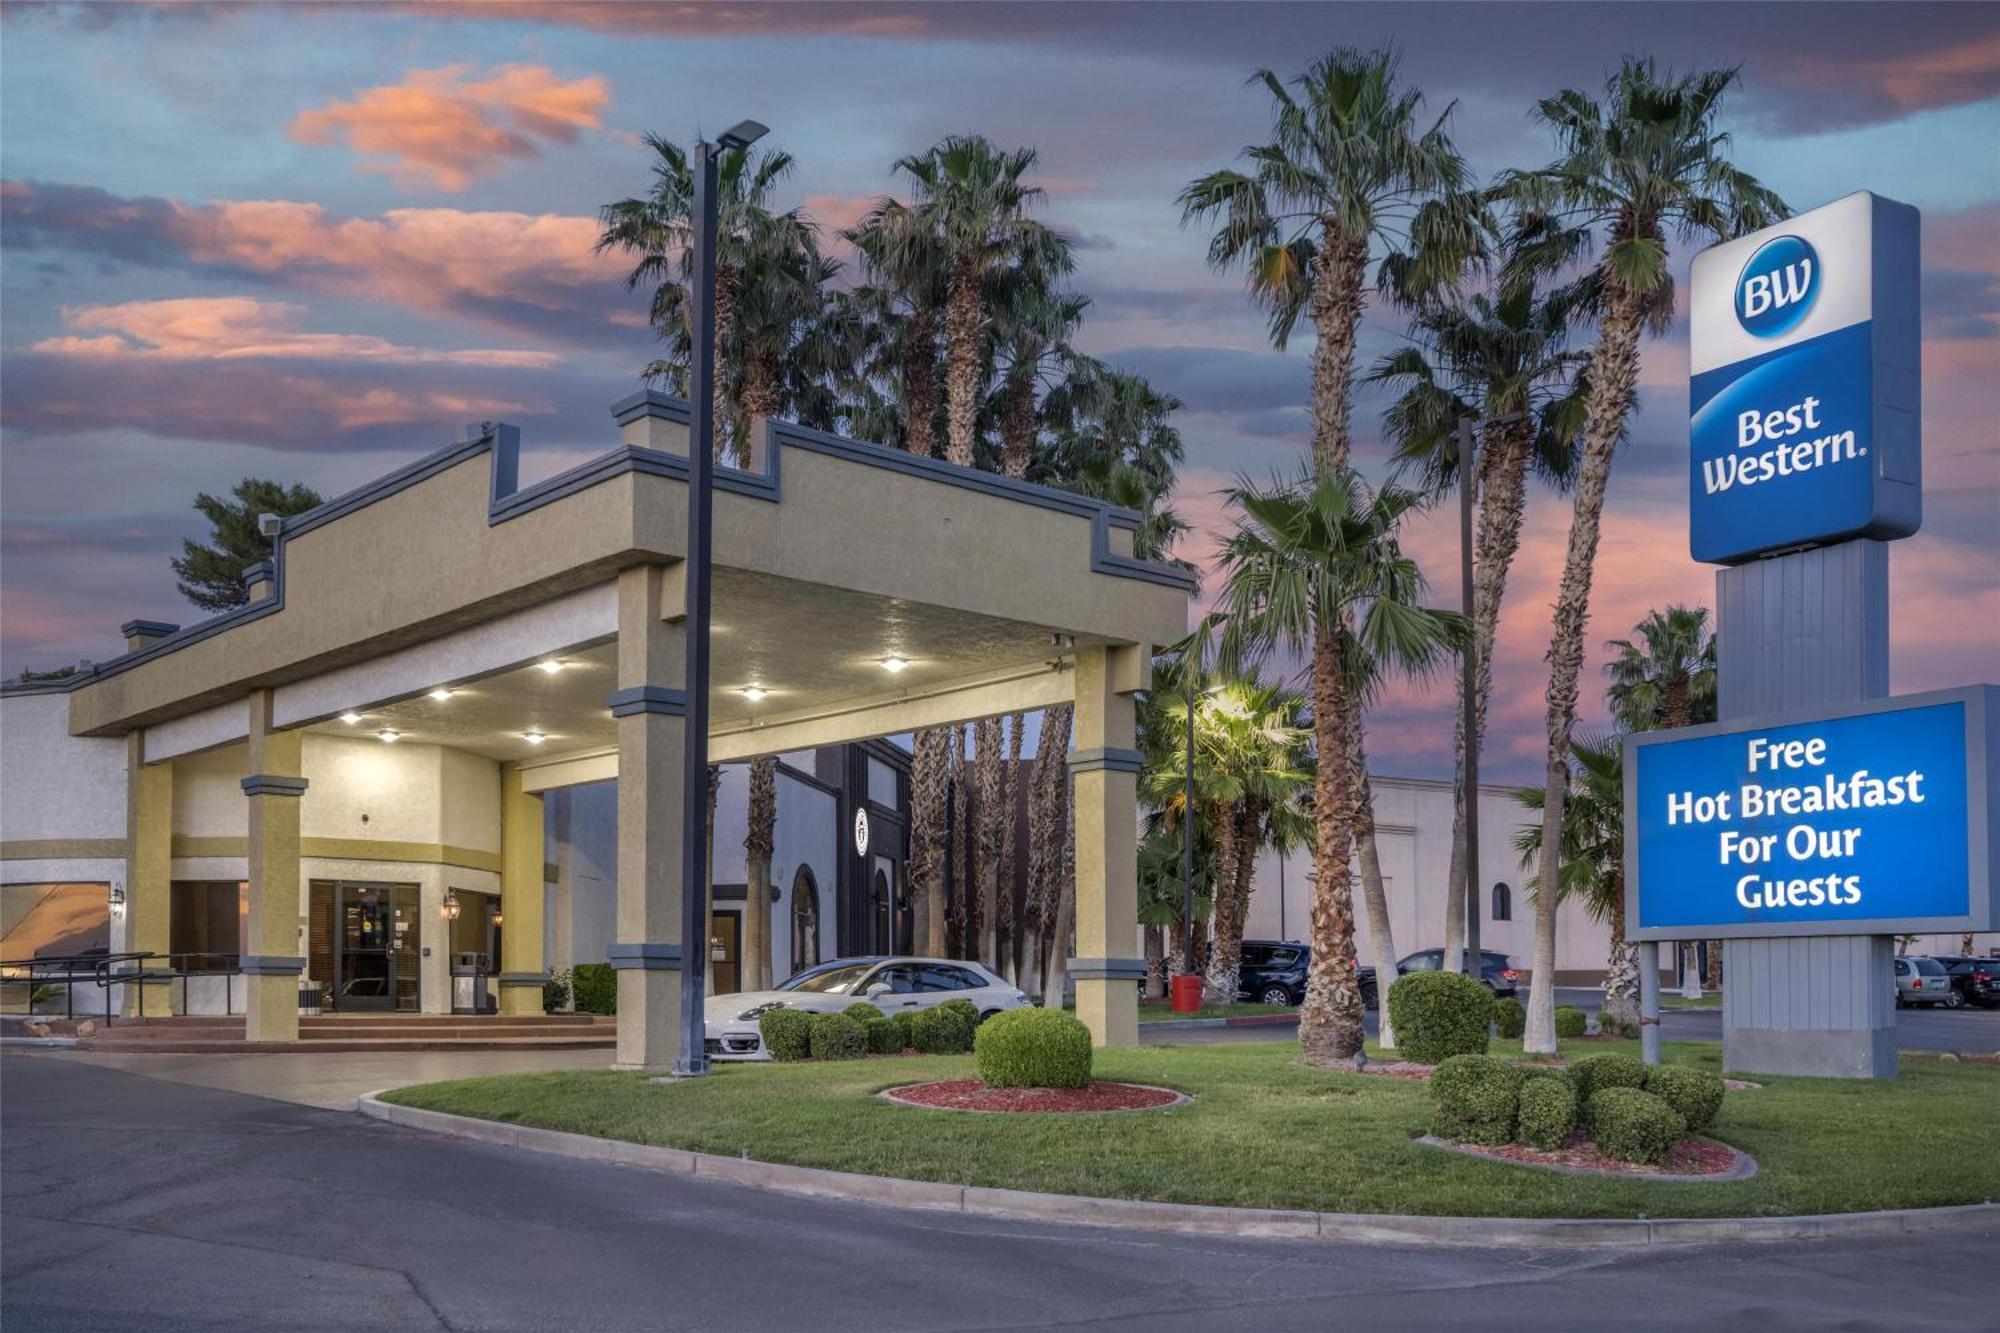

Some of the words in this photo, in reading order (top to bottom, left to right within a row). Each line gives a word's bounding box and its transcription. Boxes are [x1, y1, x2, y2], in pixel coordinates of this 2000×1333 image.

[1744, 257, 1812, 318] BW
[1737, 396, 1821, 449] Best
[1748, 737, 1827, 773] Free
[1667, 790, 1732, 826] Hot
[1740, 769, 1926, 819] Breakfast
[1719, 830, 1779, 866] For
[1785, 823, 1862, 861] Our
[1735, 873, 1862, 910] Guests
